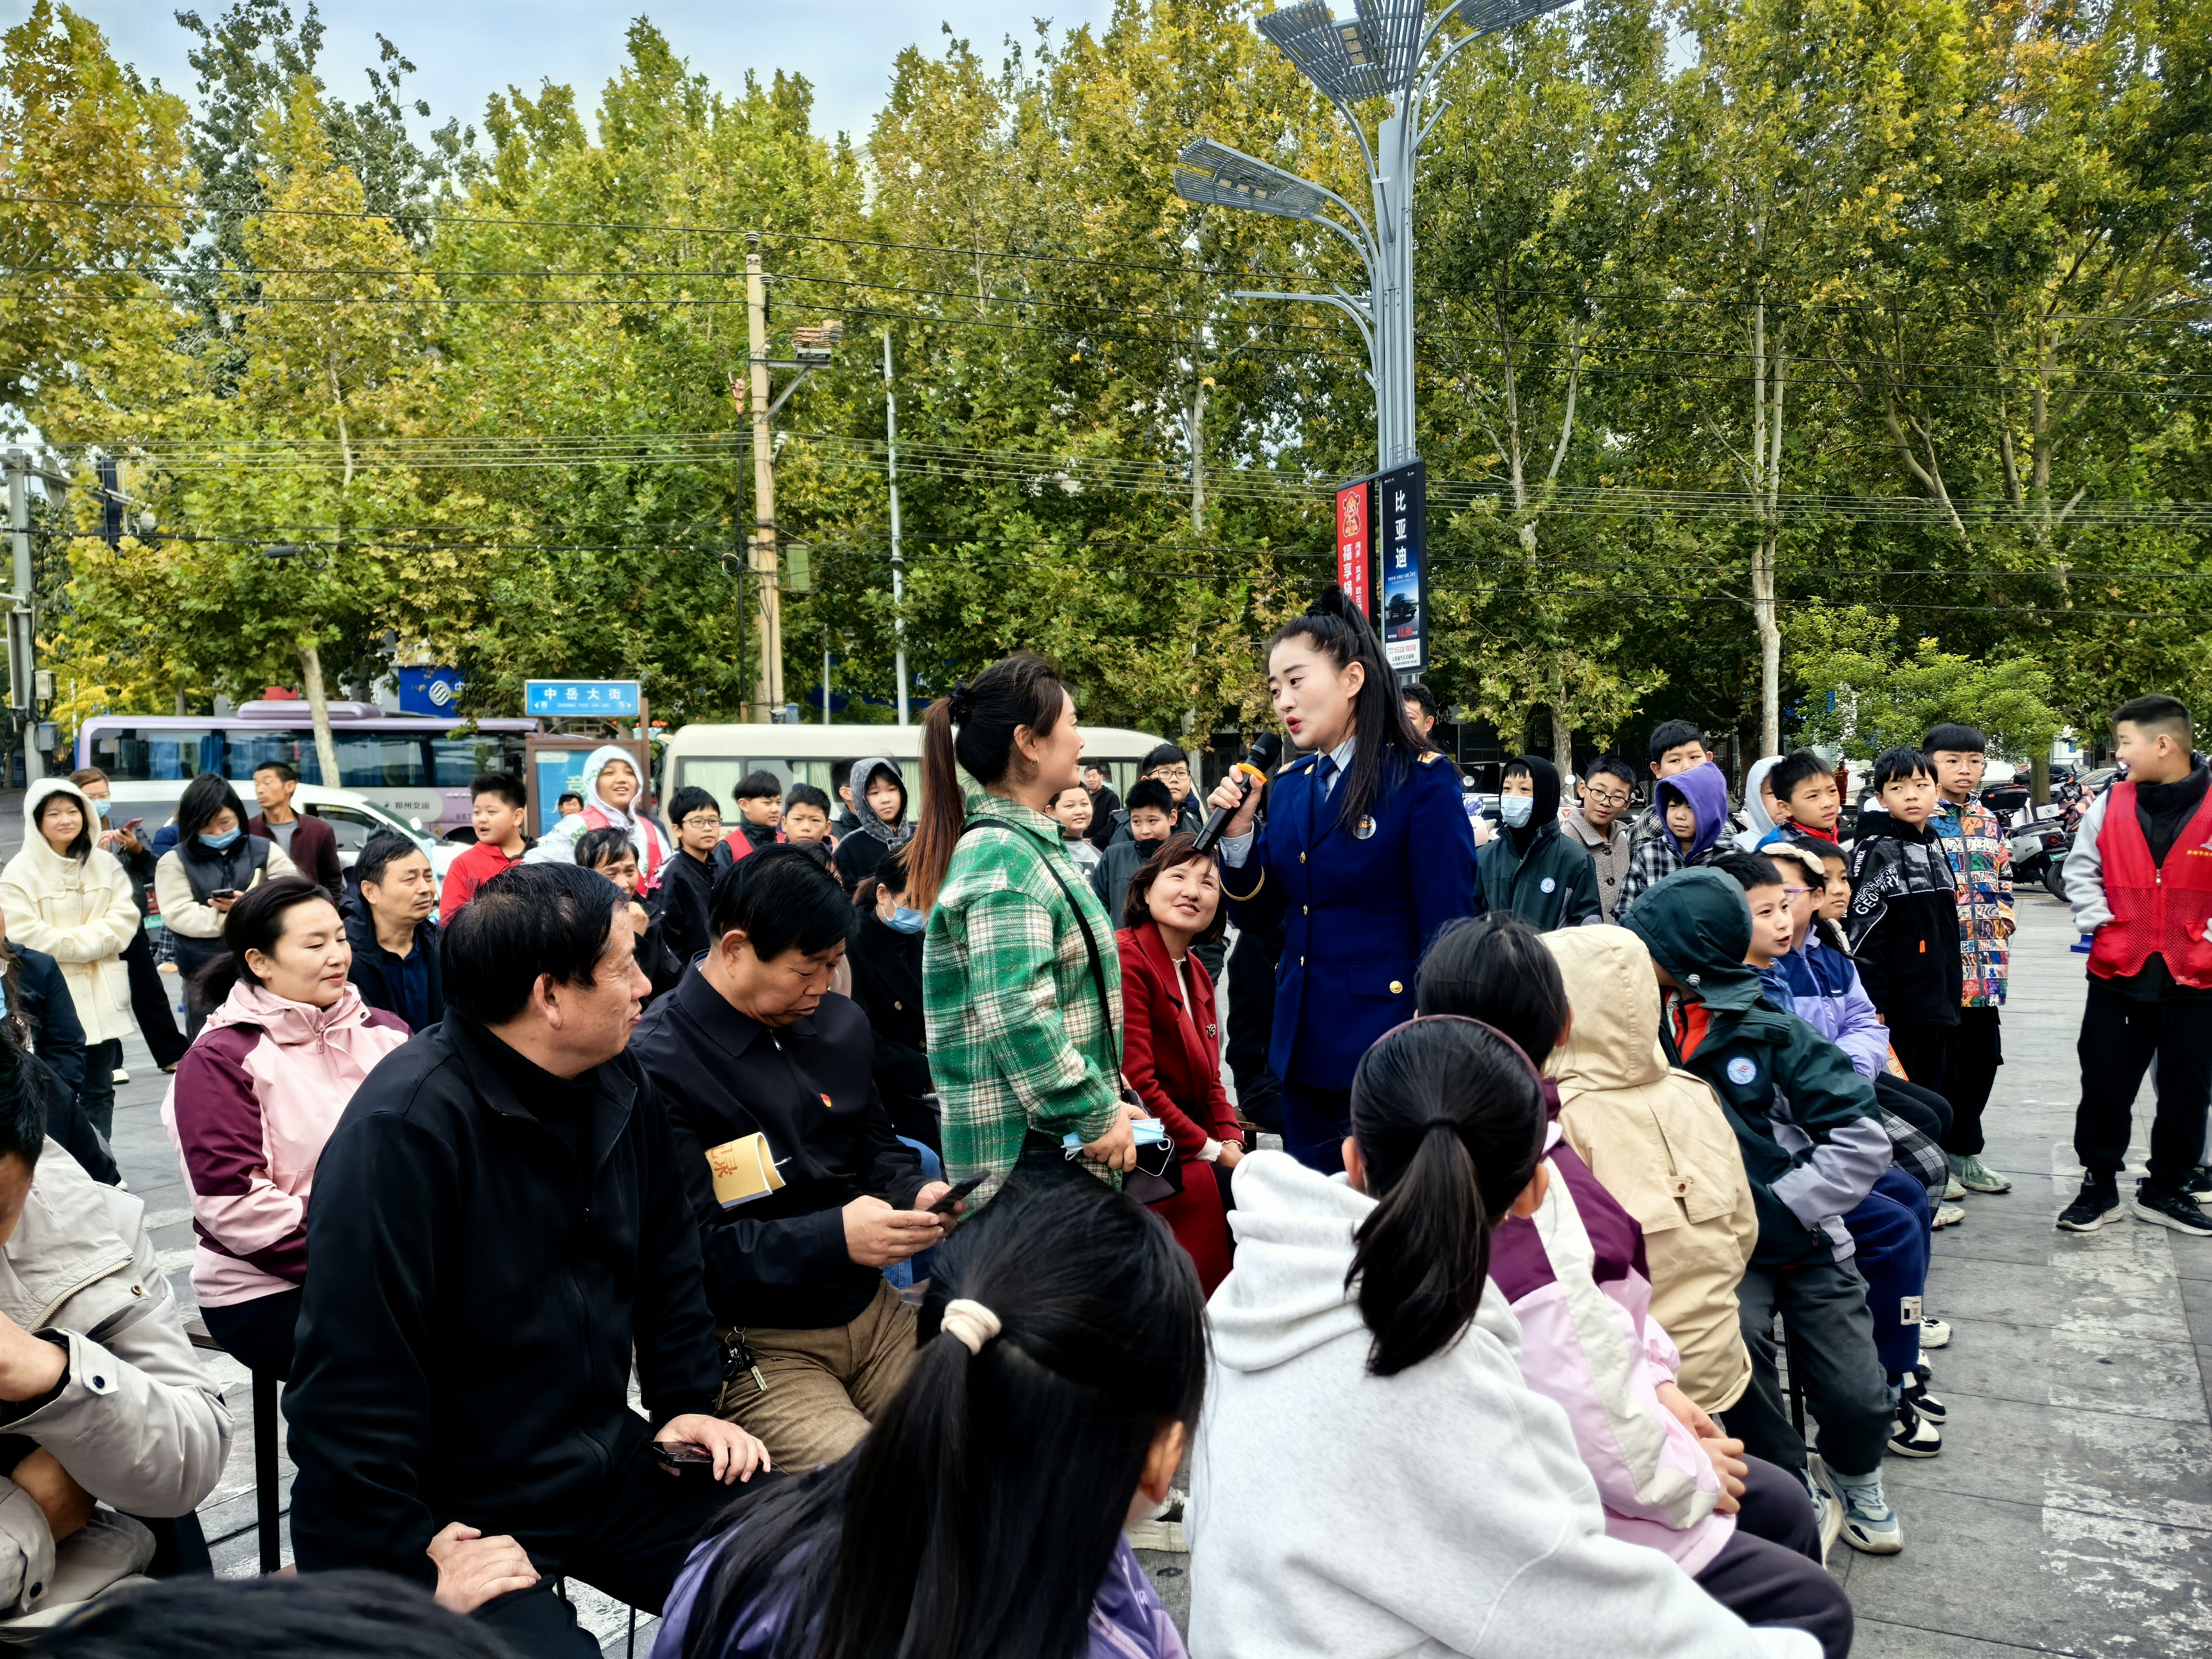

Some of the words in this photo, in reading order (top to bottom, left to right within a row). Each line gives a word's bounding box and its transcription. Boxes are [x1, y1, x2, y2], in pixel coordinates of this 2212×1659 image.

[1395, 490, 1407, 569] 比亚迪
[544, 687, 621, 700] 中岳大街
